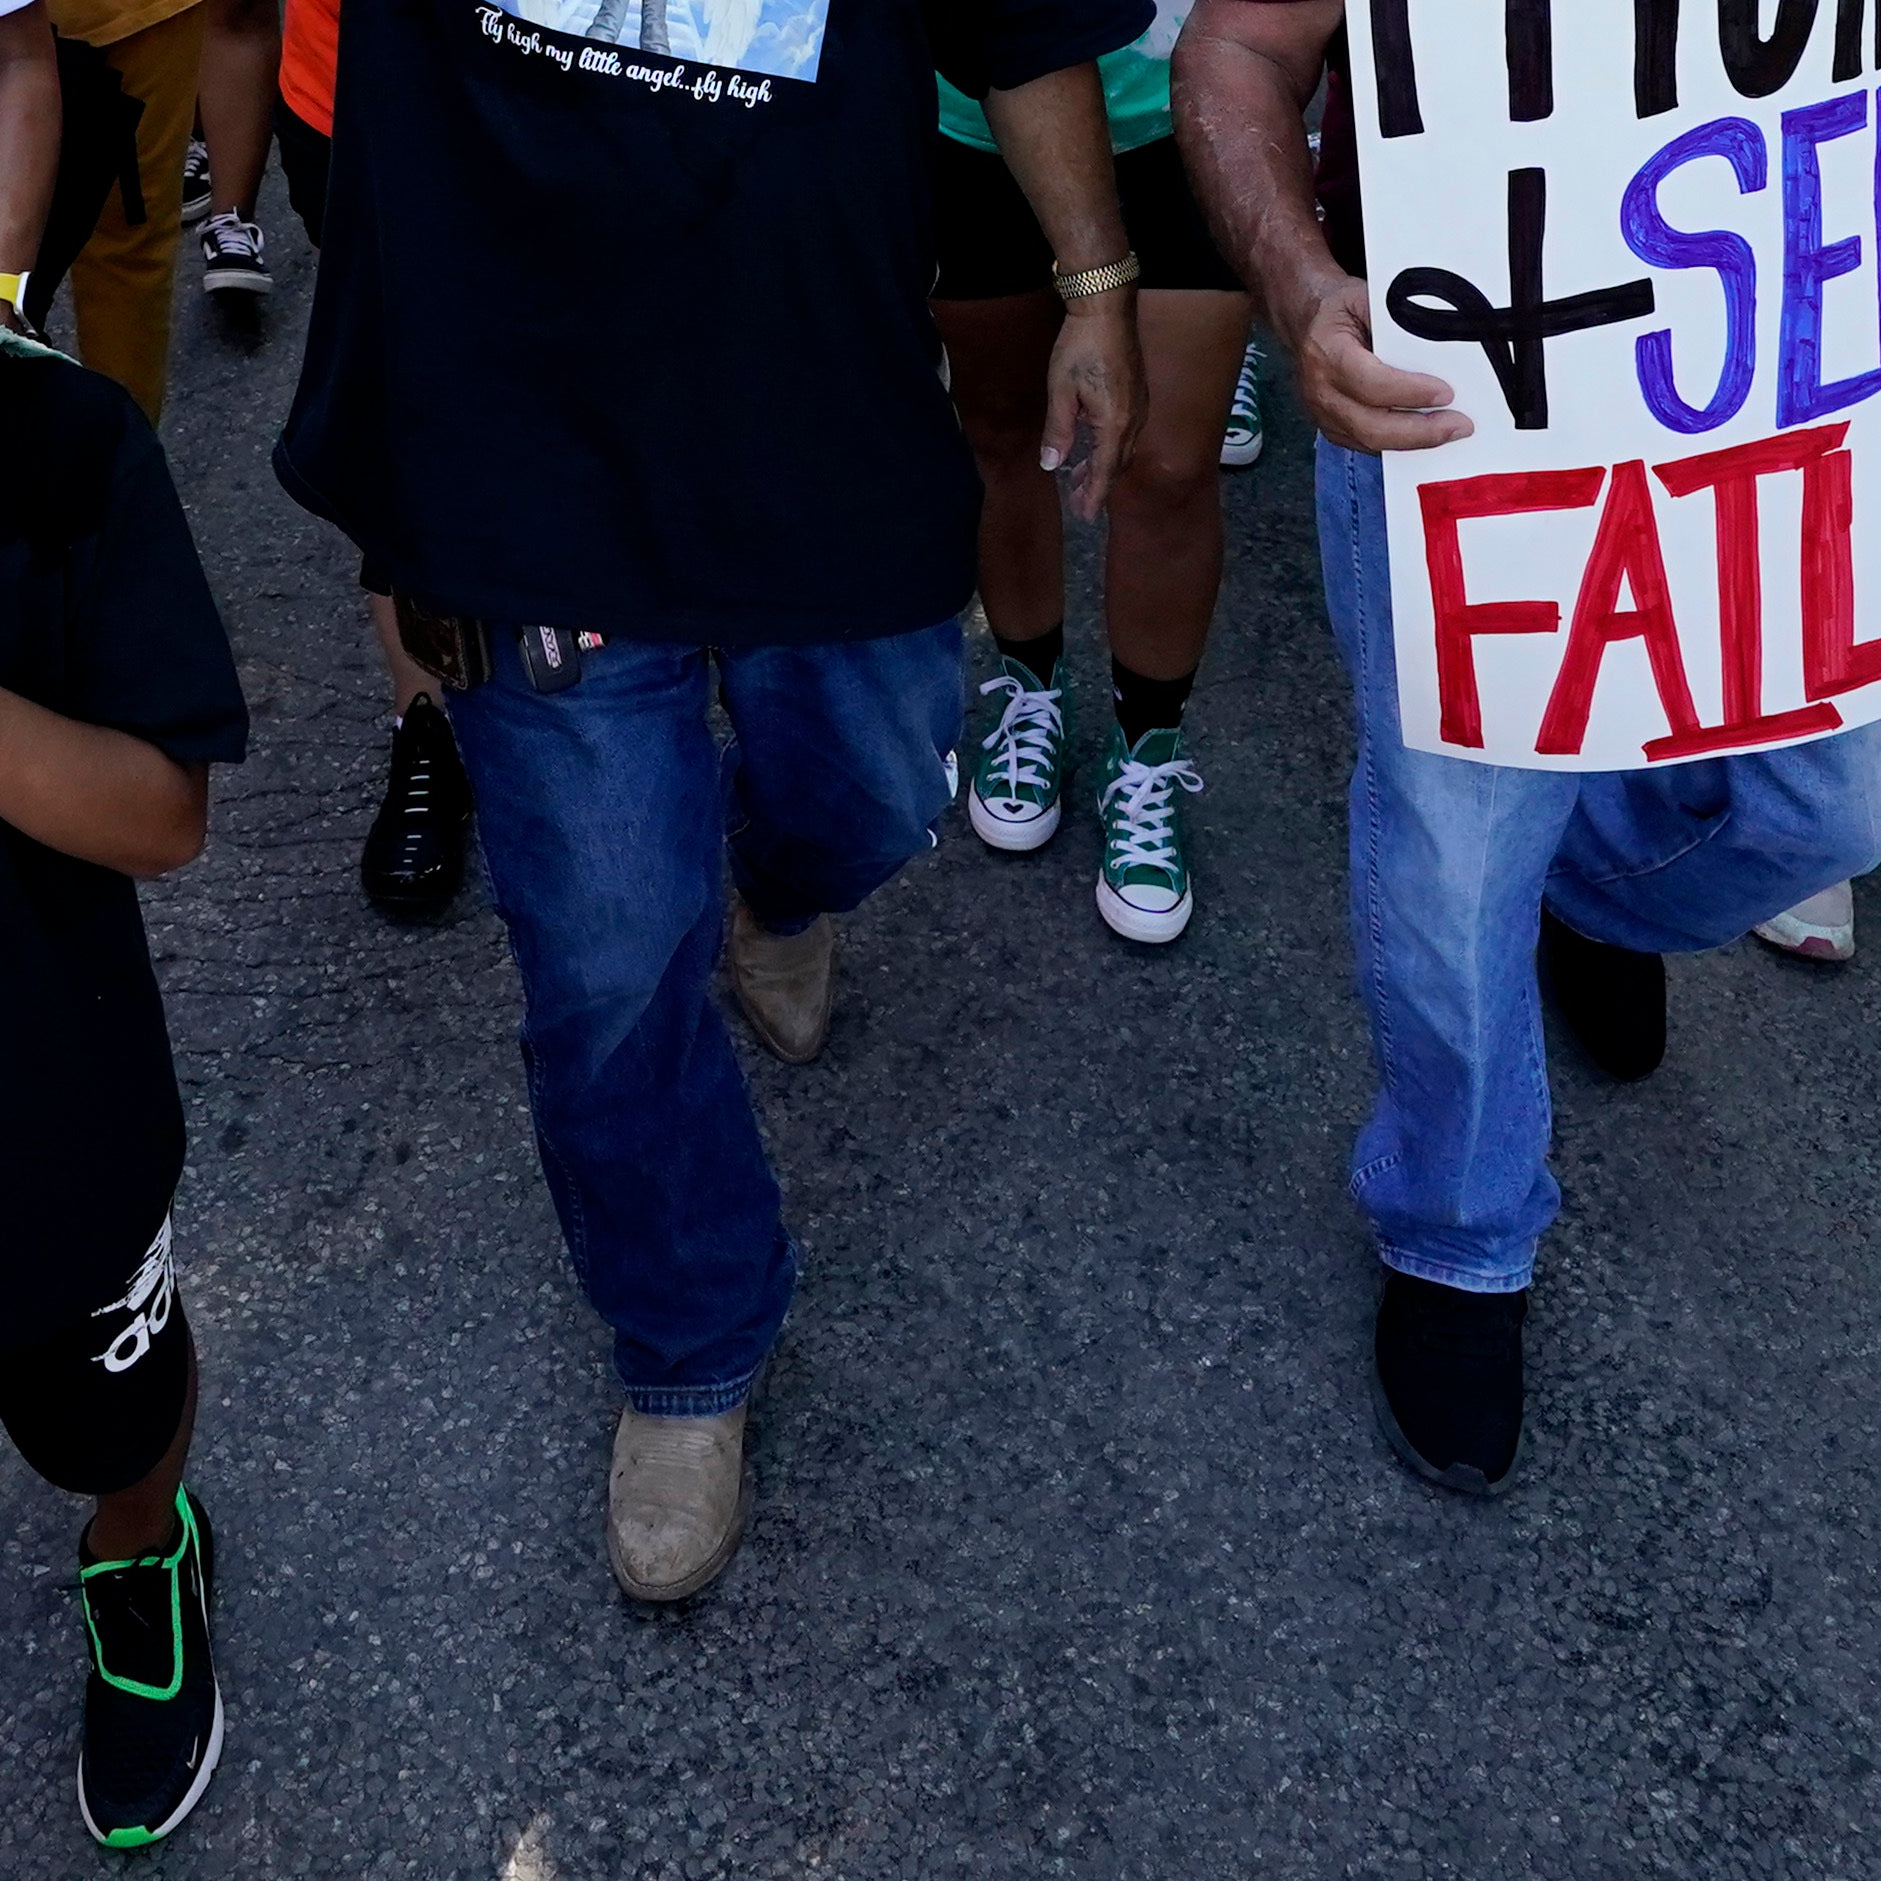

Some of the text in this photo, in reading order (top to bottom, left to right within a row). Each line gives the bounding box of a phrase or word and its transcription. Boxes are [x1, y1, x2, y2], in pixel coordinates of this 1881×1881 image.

[474, 6, 503, 45] Fly
[506, 21, 543, 56] high
[545, 44, 575, 71] my
[578, 46, 623, 77] little
[726, 74, 774, 109] high
